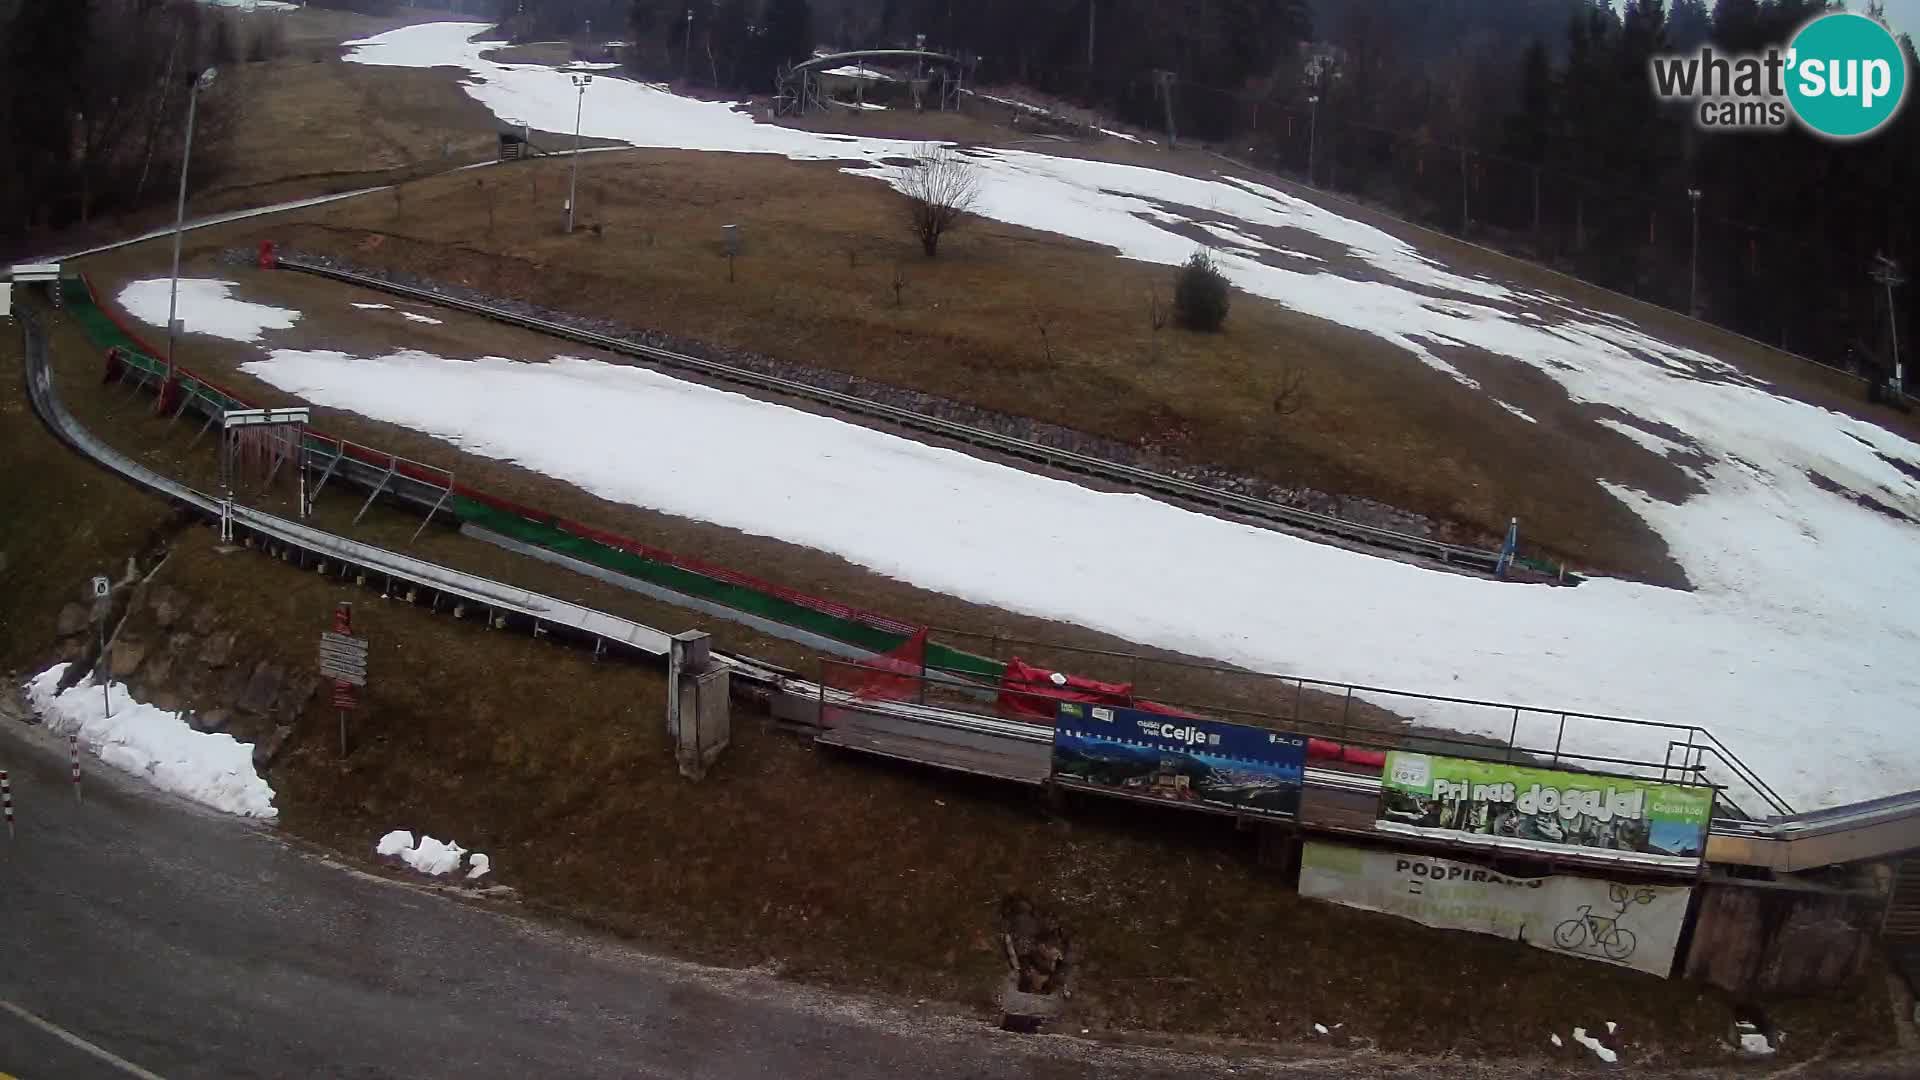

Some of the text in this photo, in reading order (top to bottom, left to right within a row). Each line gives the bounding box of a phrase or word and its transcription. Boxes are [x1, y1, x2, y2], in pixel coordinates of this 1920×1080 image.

[1160, 723, 1206, 745] Celje
[1432, 778, 1469, 801] Pri
[1473, 782, 1516, 803] nas
